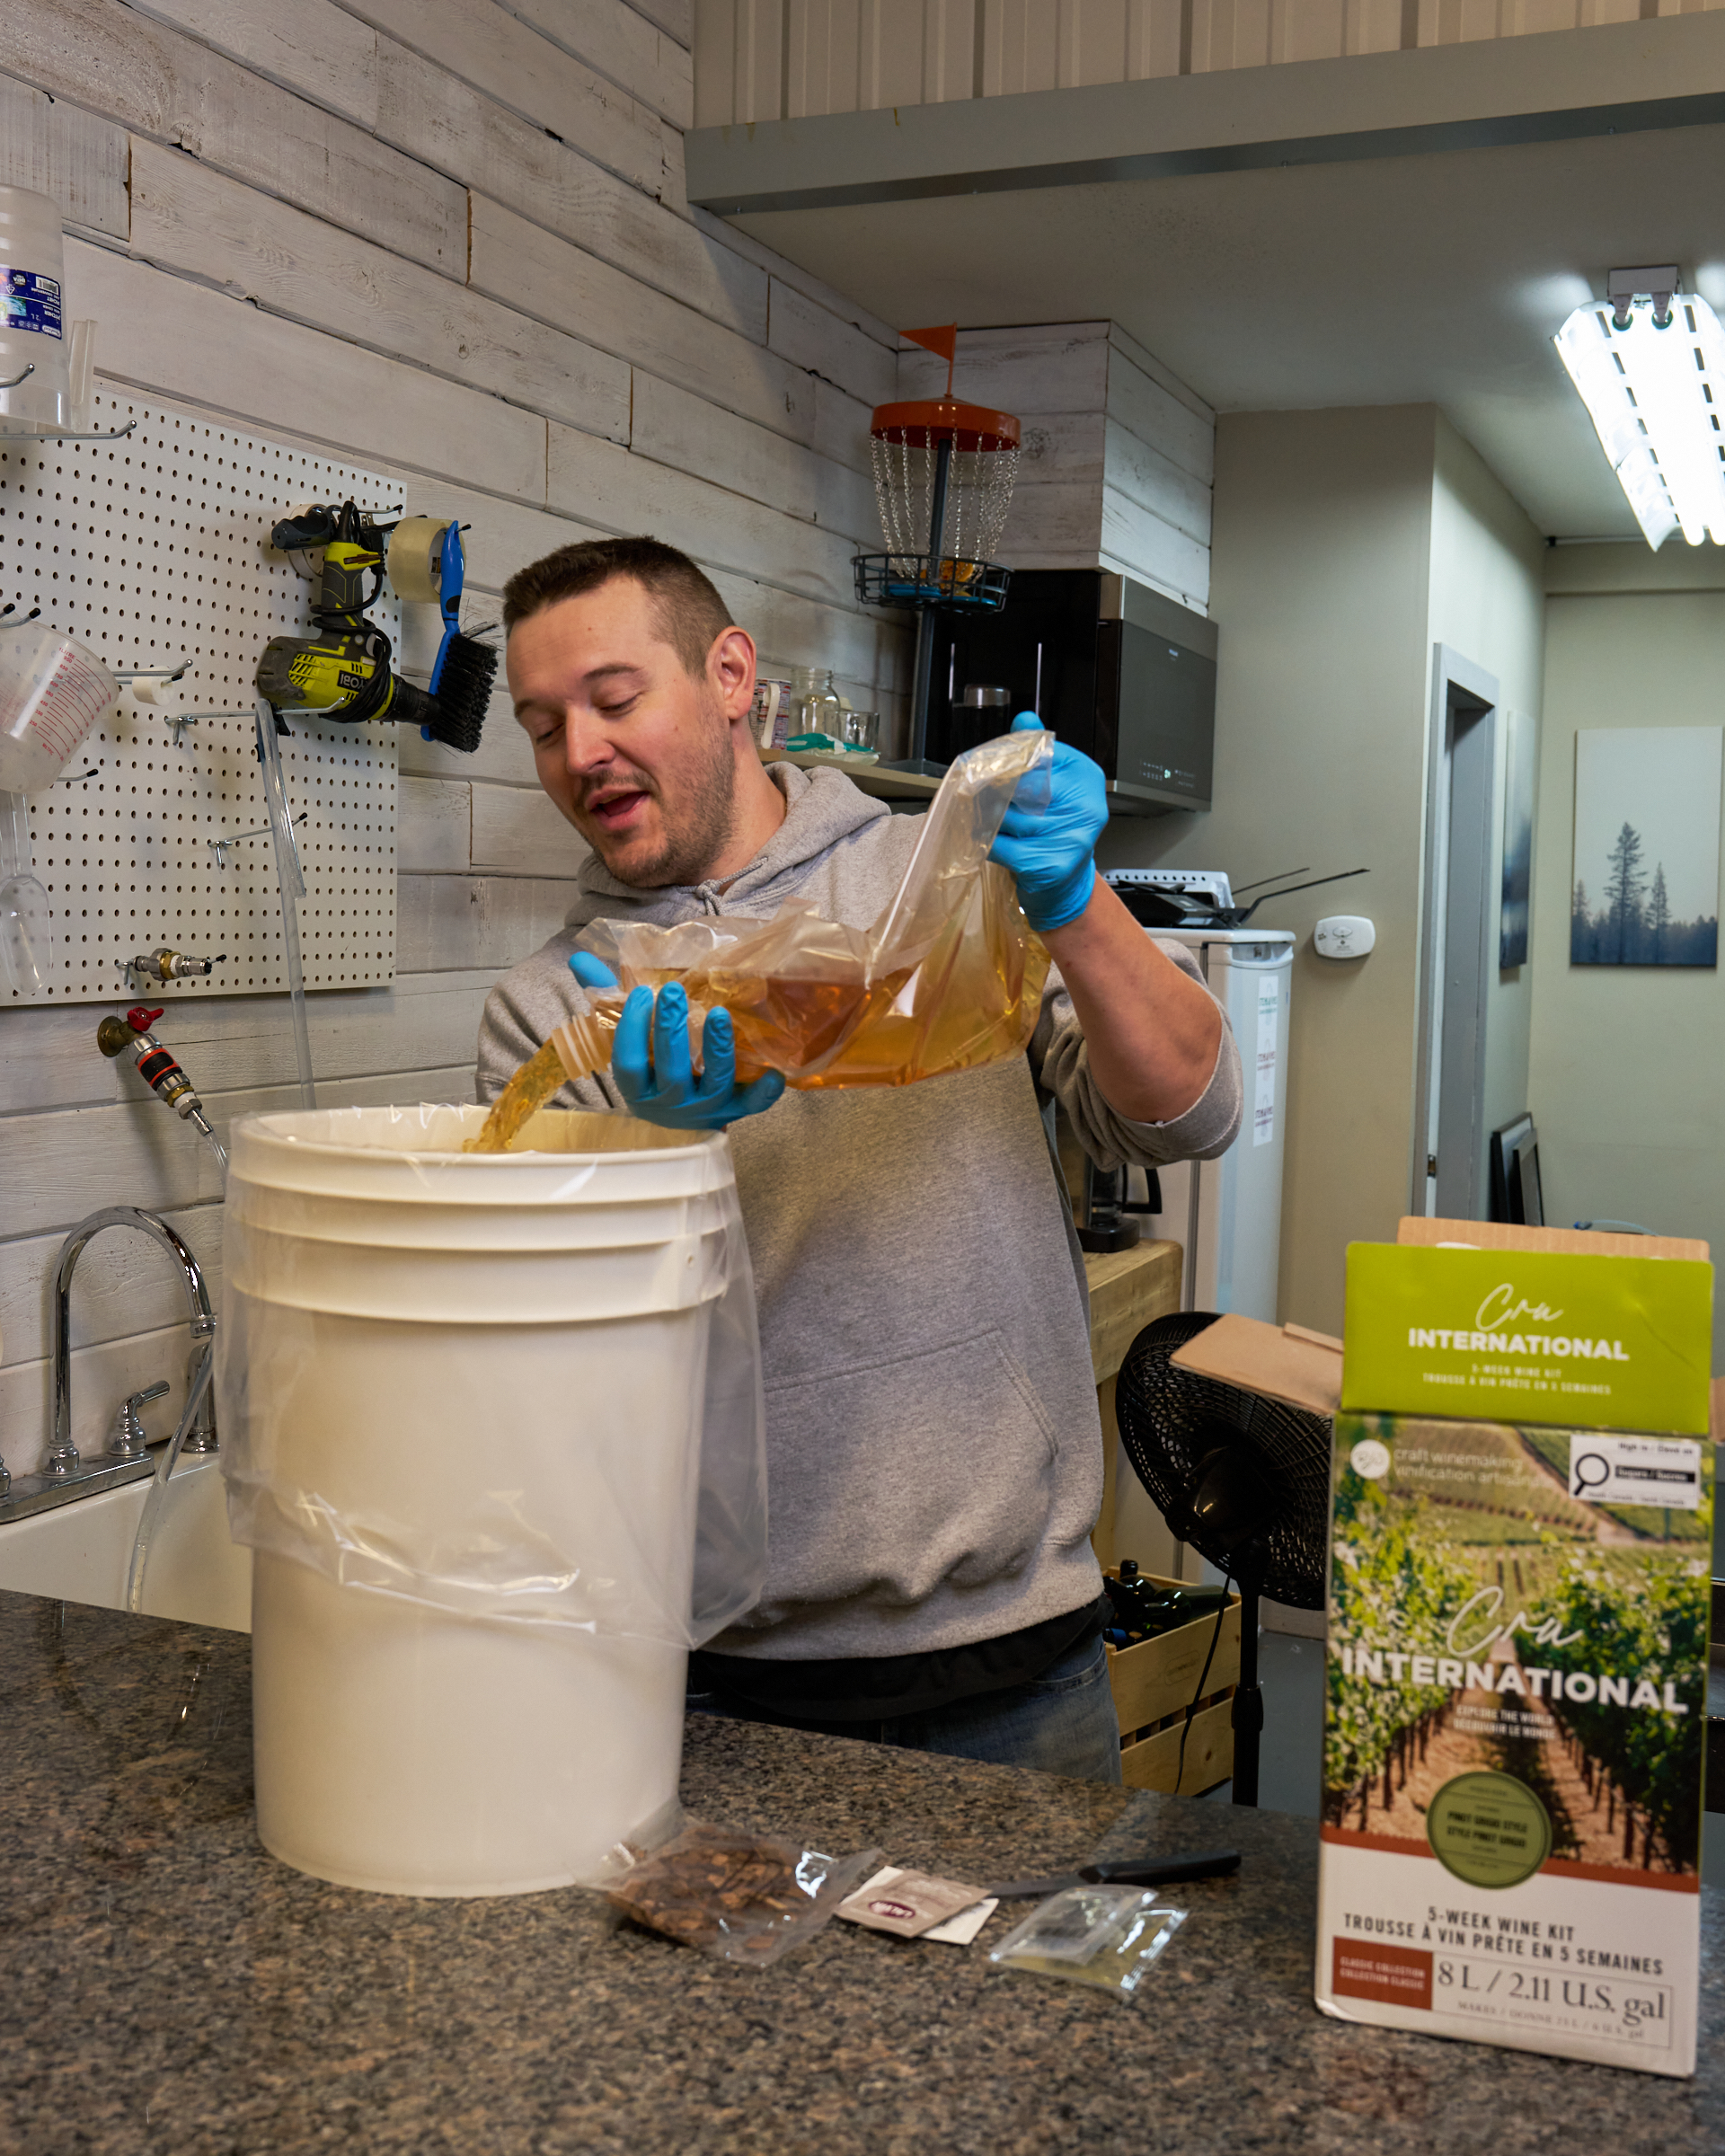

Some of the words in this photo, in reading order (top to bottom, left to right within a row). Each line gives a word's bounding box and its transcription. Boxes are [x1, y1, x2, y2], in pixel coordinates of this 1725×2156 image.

[1475, 1283, 1564, 1332] Cru
[1408, 1328, 1630, 1361] INTERNATIONAL
[1393, 1447, 1430, 1462] craft
[1431, 1452, 1524, 1474] winemaking
[1394, 1464, 1475, 1482] vinification
[1342, 1648, 1689, 1714] INTERNATIONAL
[1455, 1705, 1498, 1720] EXPLORE
[1500, 1709, 1518, 1723] THE
[1519, 1711, 1553, 1726] WORLD
[1508, 1725, 1521, 1737] LE
[1429, 1906, 1491, 1930] 5-WEEK
[1498, 1915, 1540, 1942] WINE
[1548, 1922, 1574, 1943] KIT
[1344, 1913, 1414, 1940] TROUSSE
[1422, 1922, 1432, 1940] À
[1438, 1927, 1465, 1947] VIN
[1473, 1931, 1524, 1957] PRÊTE
[1532, 1940, 1553, 1959] EN
[1560, 1943, 1570, 1962] 5
[1576, 1948, 1664, 1975] SEMAINES
[1438, 1960, 1454, 1987] 8
[1462, 1964, 1481, 1993] L
[1487, 1969, 1502, 1993] /
[1509, 1971, 1550, 2001] 2.11
[1562, 1978, 1615, 2014] U.S.
[1622, 1992, 1665, 2027] gal
